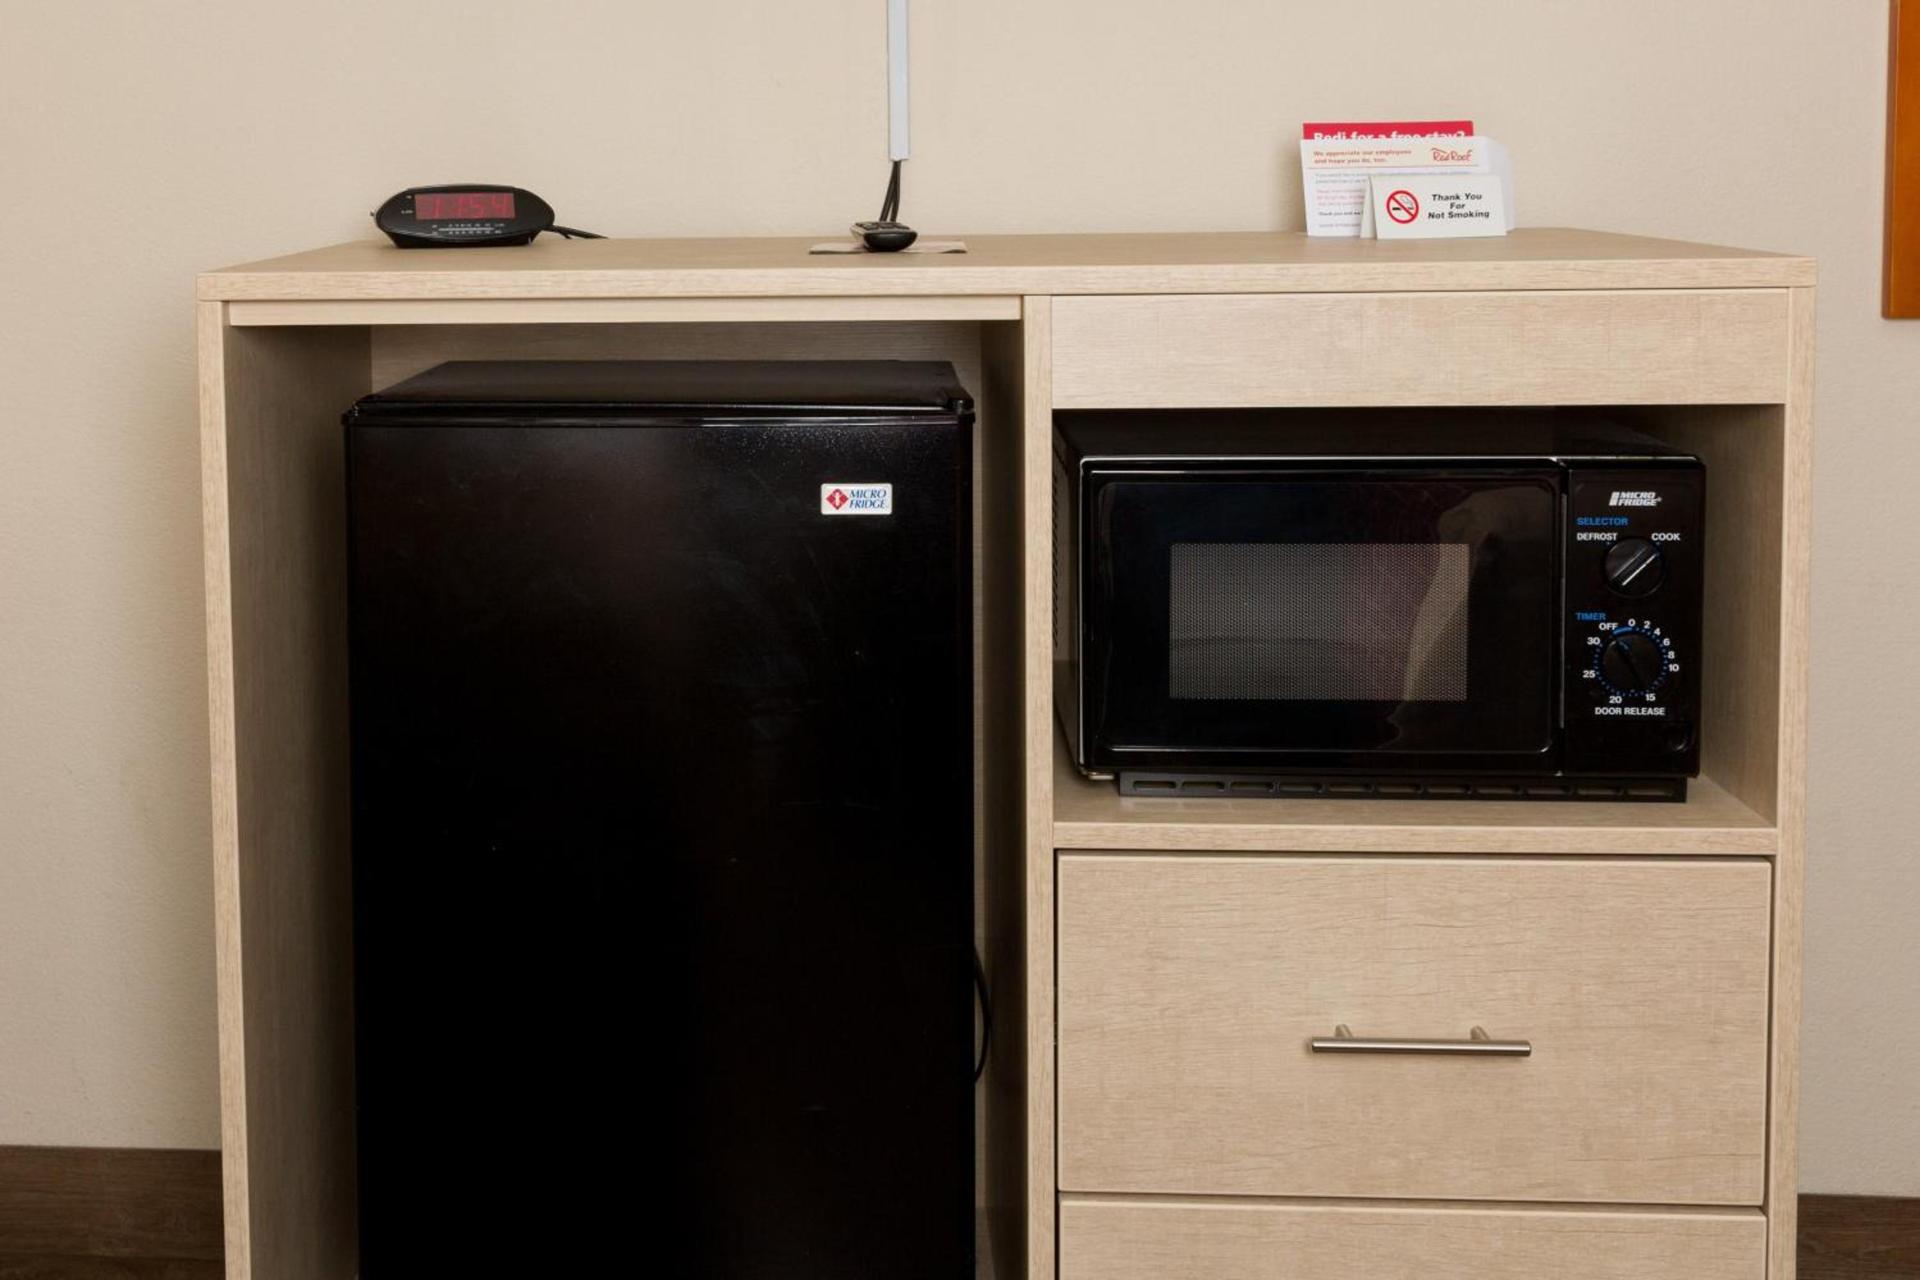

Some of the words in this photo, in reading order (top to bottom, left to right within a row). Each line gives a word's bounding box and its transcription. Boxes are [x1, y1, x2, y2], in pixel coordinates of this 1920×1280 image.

[1431, 193, 1461, 201] Thank
[1464, 192, 1483, 201] You
[1449, 202, 1466, 210] For
[1427, 211, 1446, 219] Not
[1447, 210, 1490, 219] Smoking
[849, 489, 887, 499] MICRO
[1619, 491, 1656, 499] MICRO
[849, 499, 887, 509] FRIDGE
[1576, 517, 1628, 526] SELECTOR
[1576, 532, 1618, 541] DEFROST
[1651, 532, 1681, 541] COOK
[1575, 612, 1606, 621] TIMER
[1598, 622, 1618, 631] OFF
[1628, 618, 1636, 627] 0
[1643, 620, 1651, 629] 2
[1653, 627, 1661, 636] 4
[1587, 636, 1601, 645] 30
[1663, 638, 1671, 646] 6
[1667, 650, 1675, 659] 8
[1668, 663, 1680, 672] 10
[1582, 669, 1596, 678] 25
[1609, 695, 1622, 704] 20
[1645, 693, 1656, 702] 15
[1594, 707, 1622, 715] DOOR
[1623, 707, 1666, 715] RELEASE
